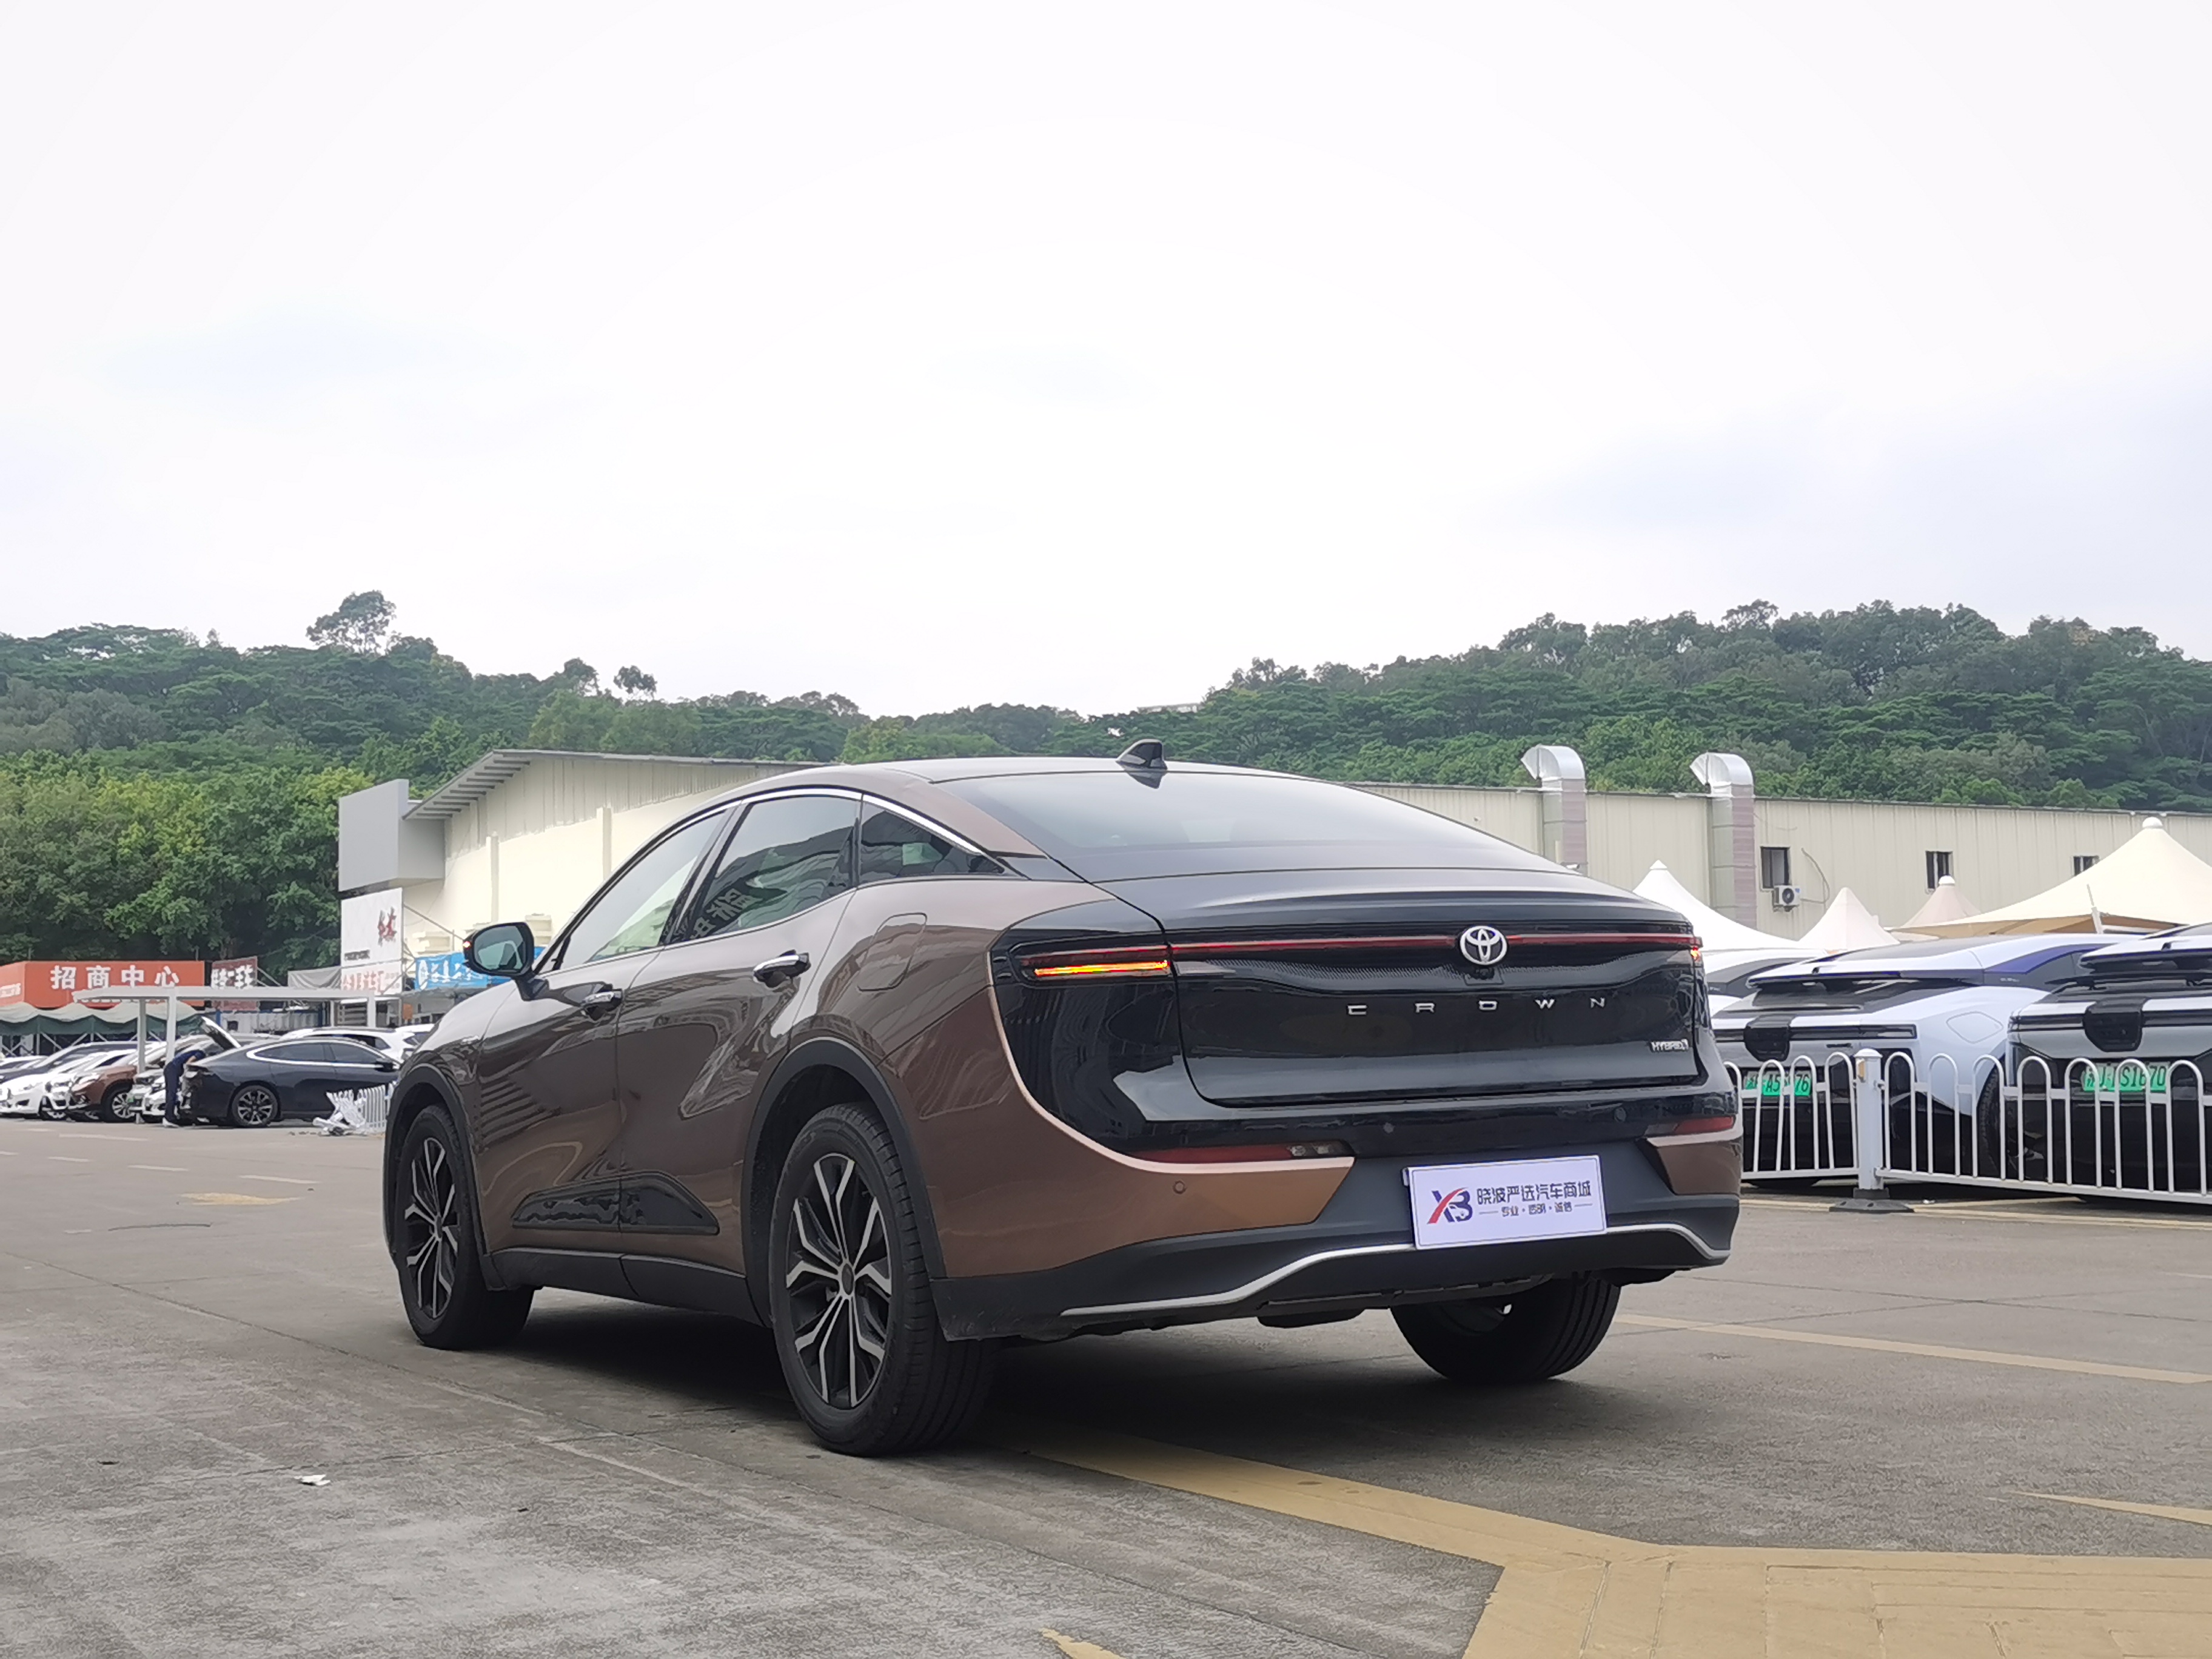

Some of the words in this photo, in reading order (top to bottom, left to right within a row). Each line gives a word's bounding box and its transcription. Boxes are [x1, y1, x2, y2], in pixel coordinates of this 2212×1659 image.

[50, 965, 179, 988] 招商中心
[1347, 996, 1606, 1016] CROWN
[1476, 1180, 1592, 1205] 晓波严选汽车商城
